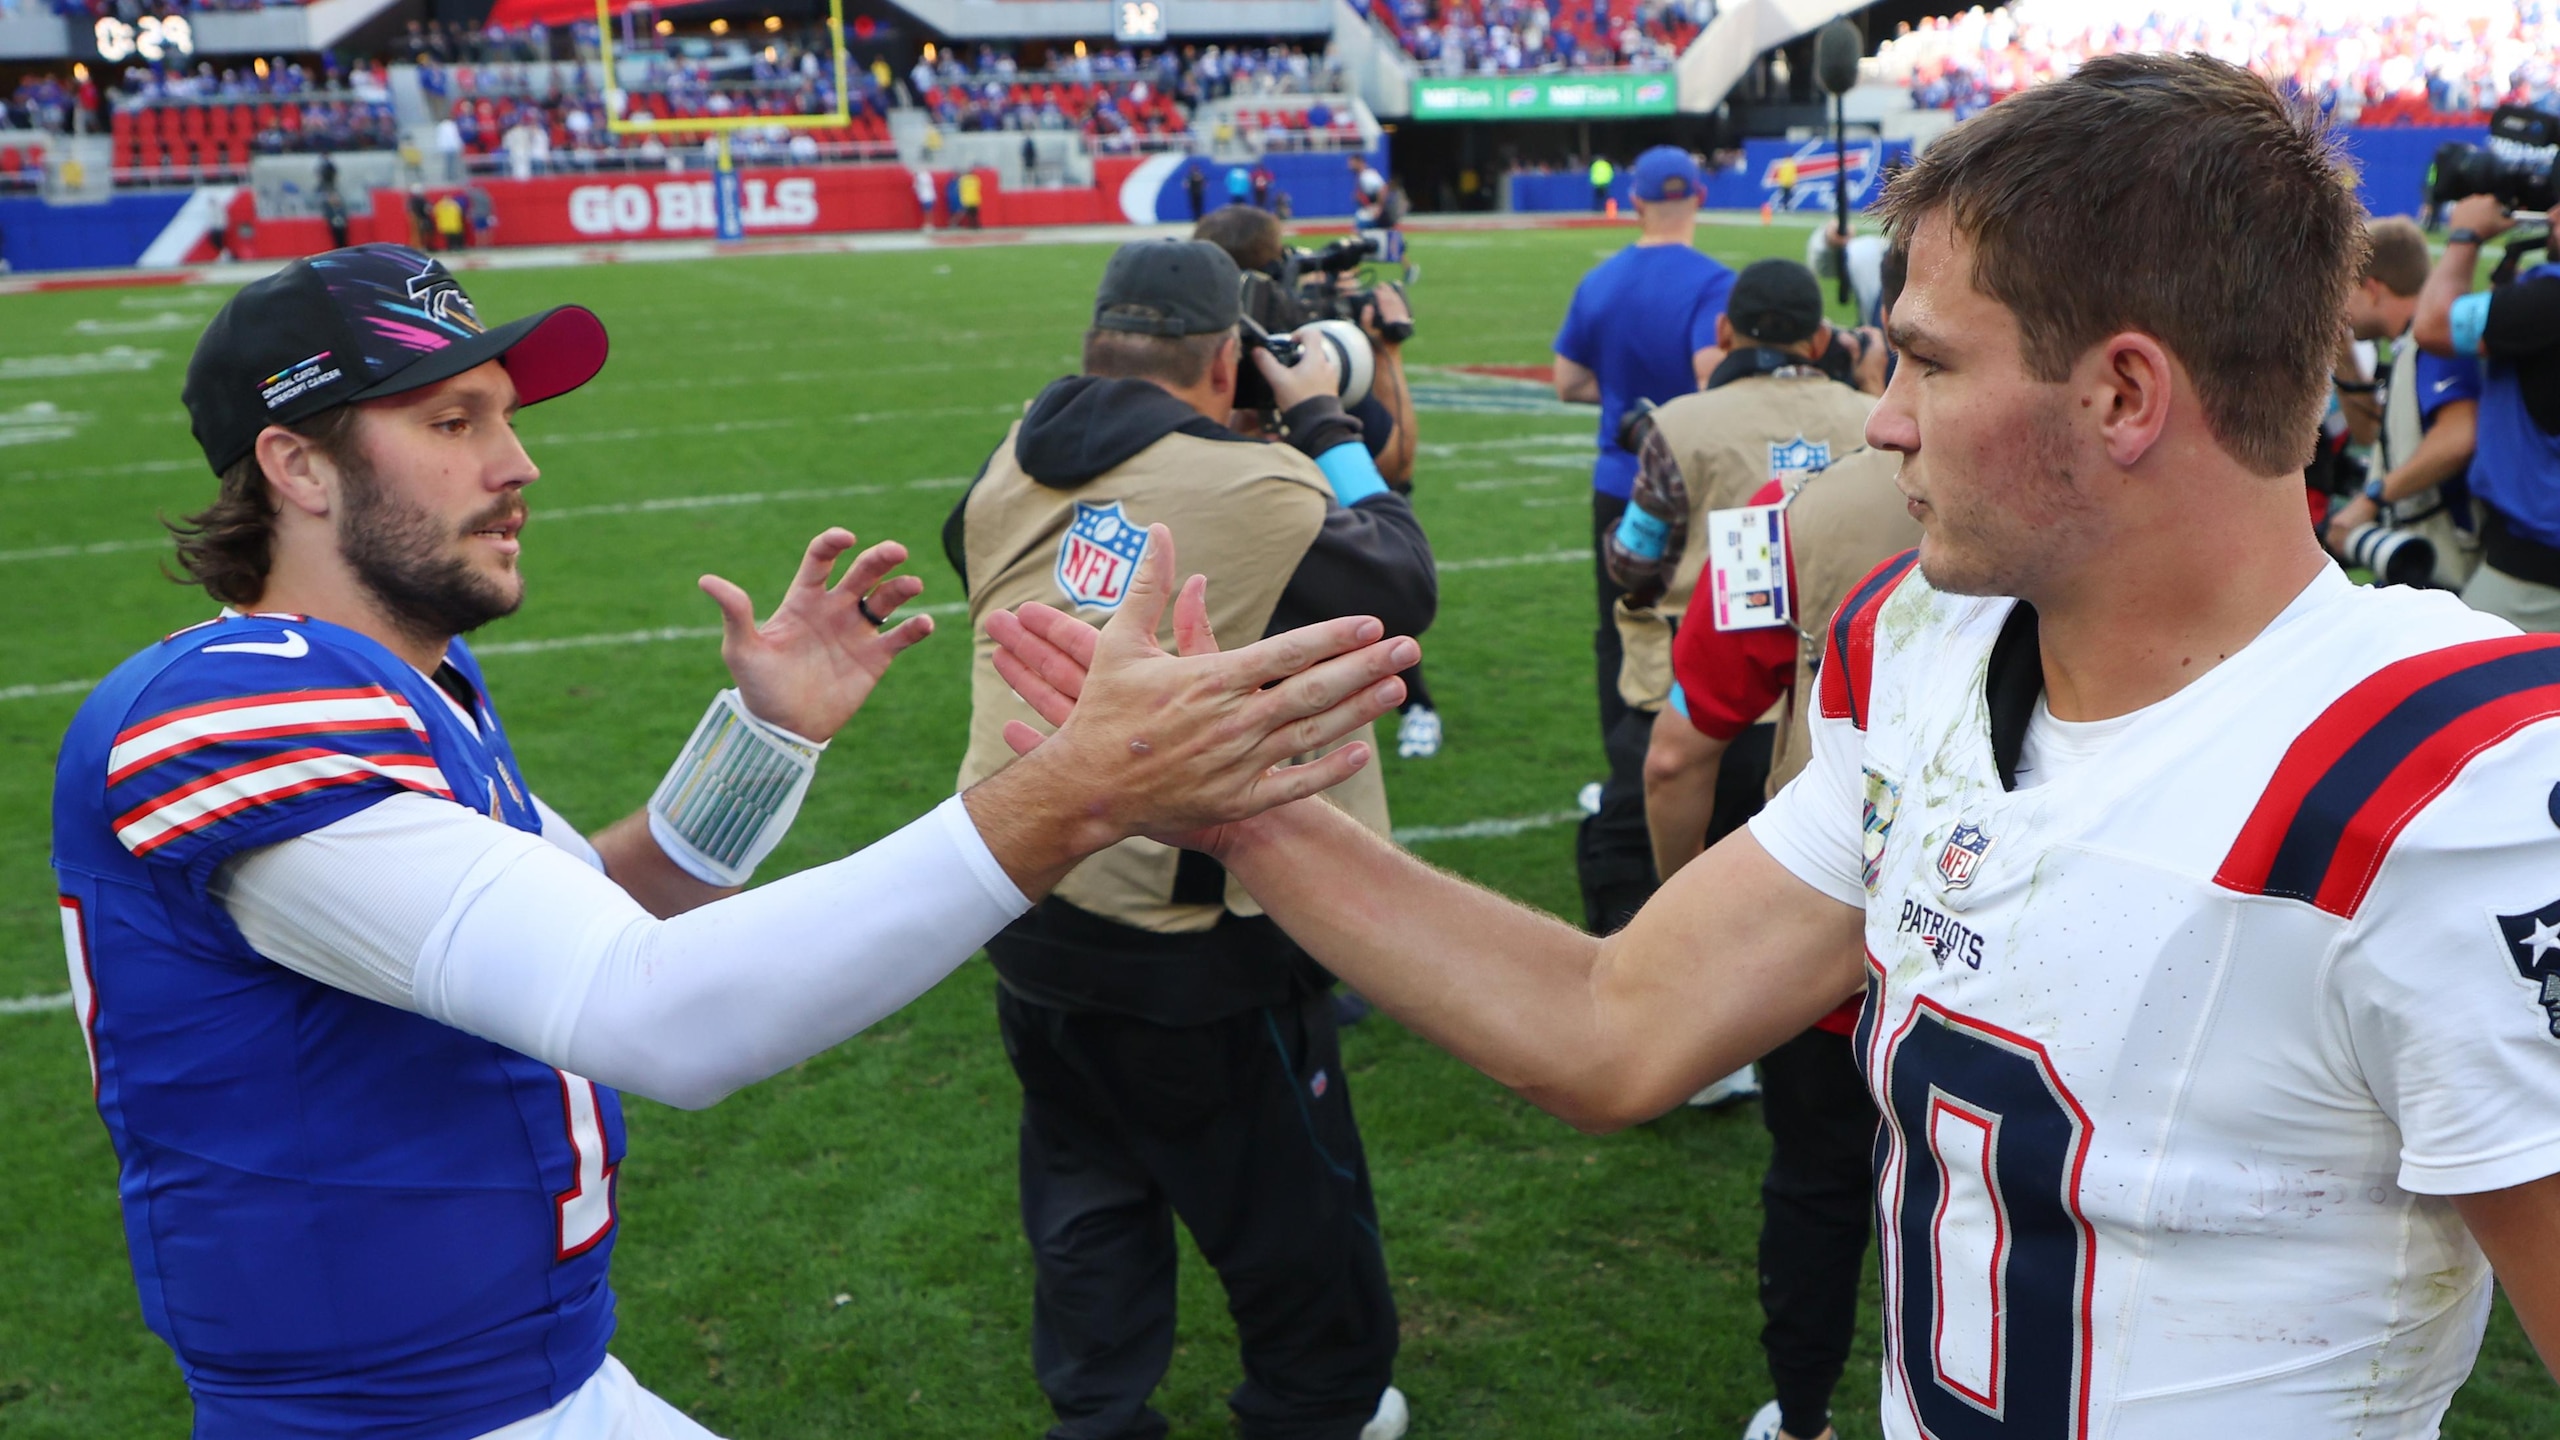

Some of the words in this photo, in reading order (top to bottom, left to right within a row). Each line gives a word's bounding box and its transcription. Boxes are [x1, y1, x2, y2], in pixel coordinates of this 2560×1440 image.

[94, 15, 194, 62] 0:29
[568, 184, 650, 233] GO
[654, 178, 819, 230] BILS
[1064, 538, 1119, 599] NFL
[1940, 845, 1973, 880] NFL
[1897, 899, 1985, 971] PATRIOTS
